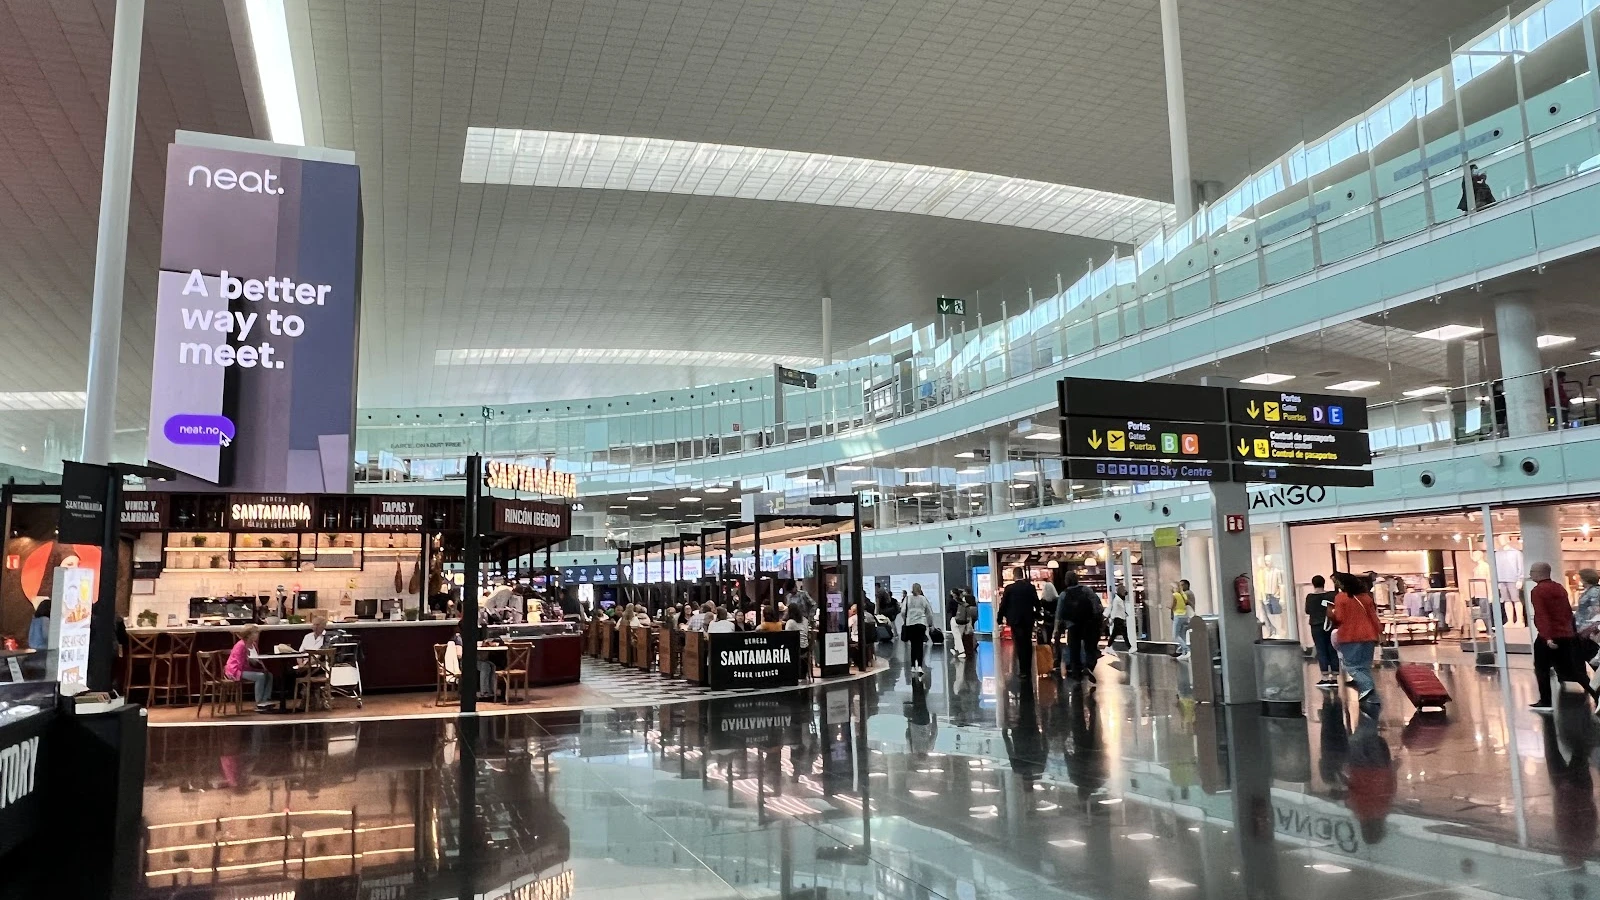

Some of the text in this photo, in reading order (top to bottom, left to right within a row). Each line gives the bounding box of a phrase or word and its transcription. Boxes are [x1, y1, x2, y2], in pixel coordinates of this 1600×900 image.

[188, 165, 285, 195] neat.
[182, 268, 332, 306] A better
[181, 308, 305, 341] way to
[179, 342, 285, 369] meet.
[1312, 407, 1341, 423] D E
[179, 425, 220, 435] neat.no
[1127, 421, 1151, 432] Portes
[1128, 432, 1147, 441] Gates
[1164, 436, 1196, 452] B C
[1129, 441, 1157, 451] Puertas
[1160, 465, 1213, 479] Sky Centre
[1247, 485, 1326, 510] ANGO
[124, 501, 157, 511] VINOS Y
[231, 502, 312, 520] SANTAMARÍA
[381, 501, 415, 513] TAPAS Y
[372, 514, 423, 526] MONTADITOS
[504, 507, 560, 529] RINCÓN IBÉRICO
[720, 645, 791, 666] SANTAMARÍA
[0, 736, 39, 809] TORY
